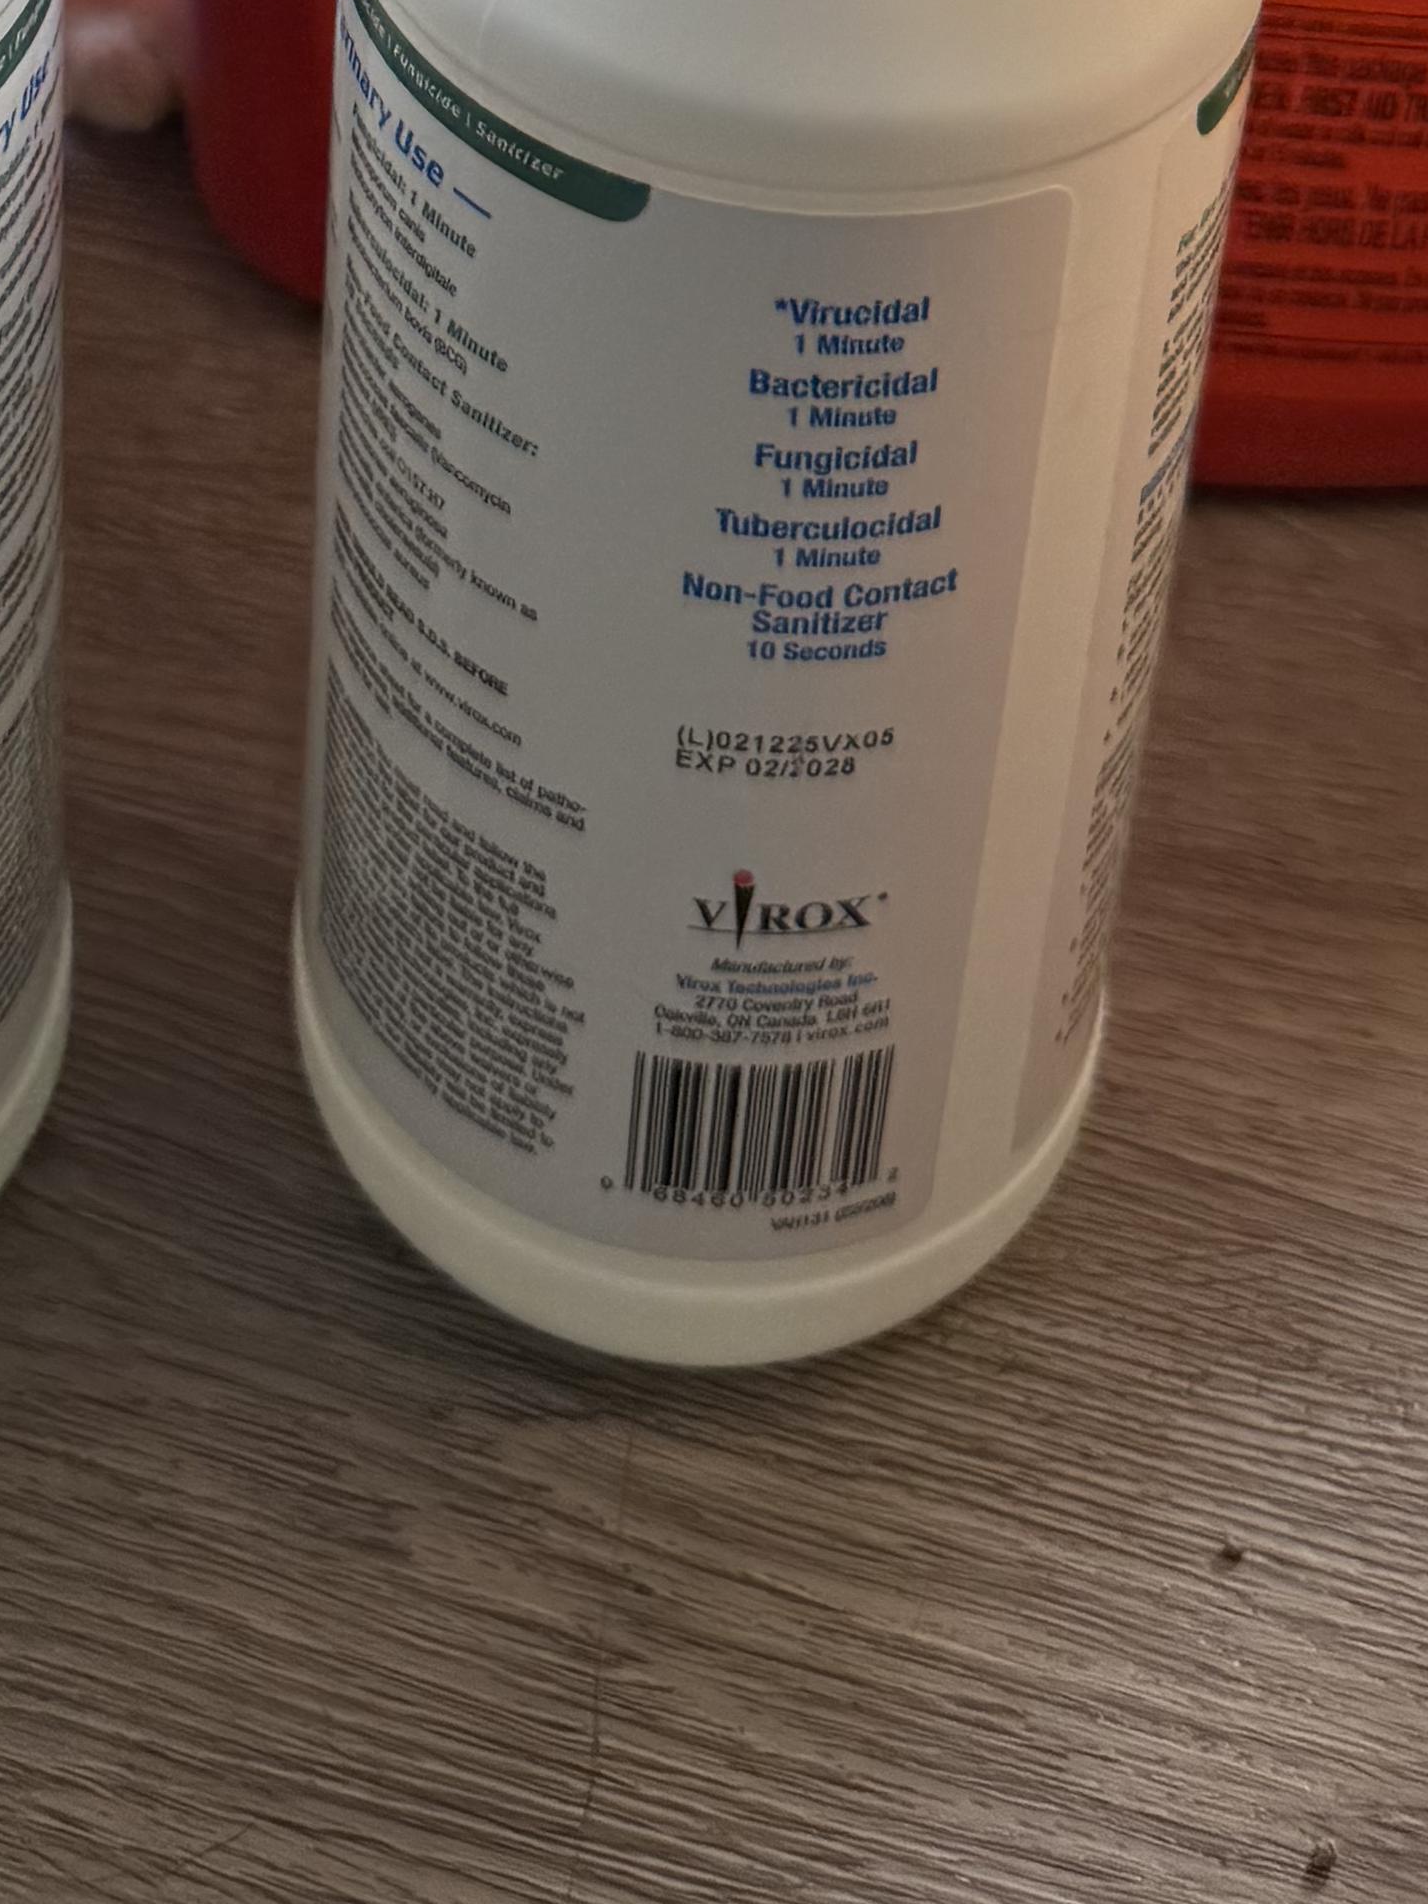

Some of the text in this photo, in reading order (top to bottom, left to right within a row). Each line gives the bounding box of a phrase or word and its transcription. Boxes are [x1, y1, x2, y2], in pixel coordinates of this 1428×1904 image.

[394, 119, 444, 187] Use
[476, 120, 564, 179] Sanitizer
[422, 202, 476, 259] Minute
[447, 319, 508, 372] Minute
[795, 334, 905, 355] 1 Minute
[749, 367, 938, 400] Bactericidal
[451, 390, 539, 457] Sanitizer:
[788, 405, 897, 427] 1 Minute
[755, 440, 917, 475] Fungicidal
[781, 477, 889, 498] 1 Minute
[715, 505, 941, 540] Tuberculocidal
[774, 547, 881, 568] 1 Minute
[682, 568, 958, 609] Non-Food Contact
[752, 609, 888, 636] Sanitizer
[747, 639, 887, 663] 10 Seconds
[677, 724, 894, 754] (L)021225VX05
[675, 749, 735, 773] EXP
[677, 972, 878, 995] Virox Technologies Inc.
